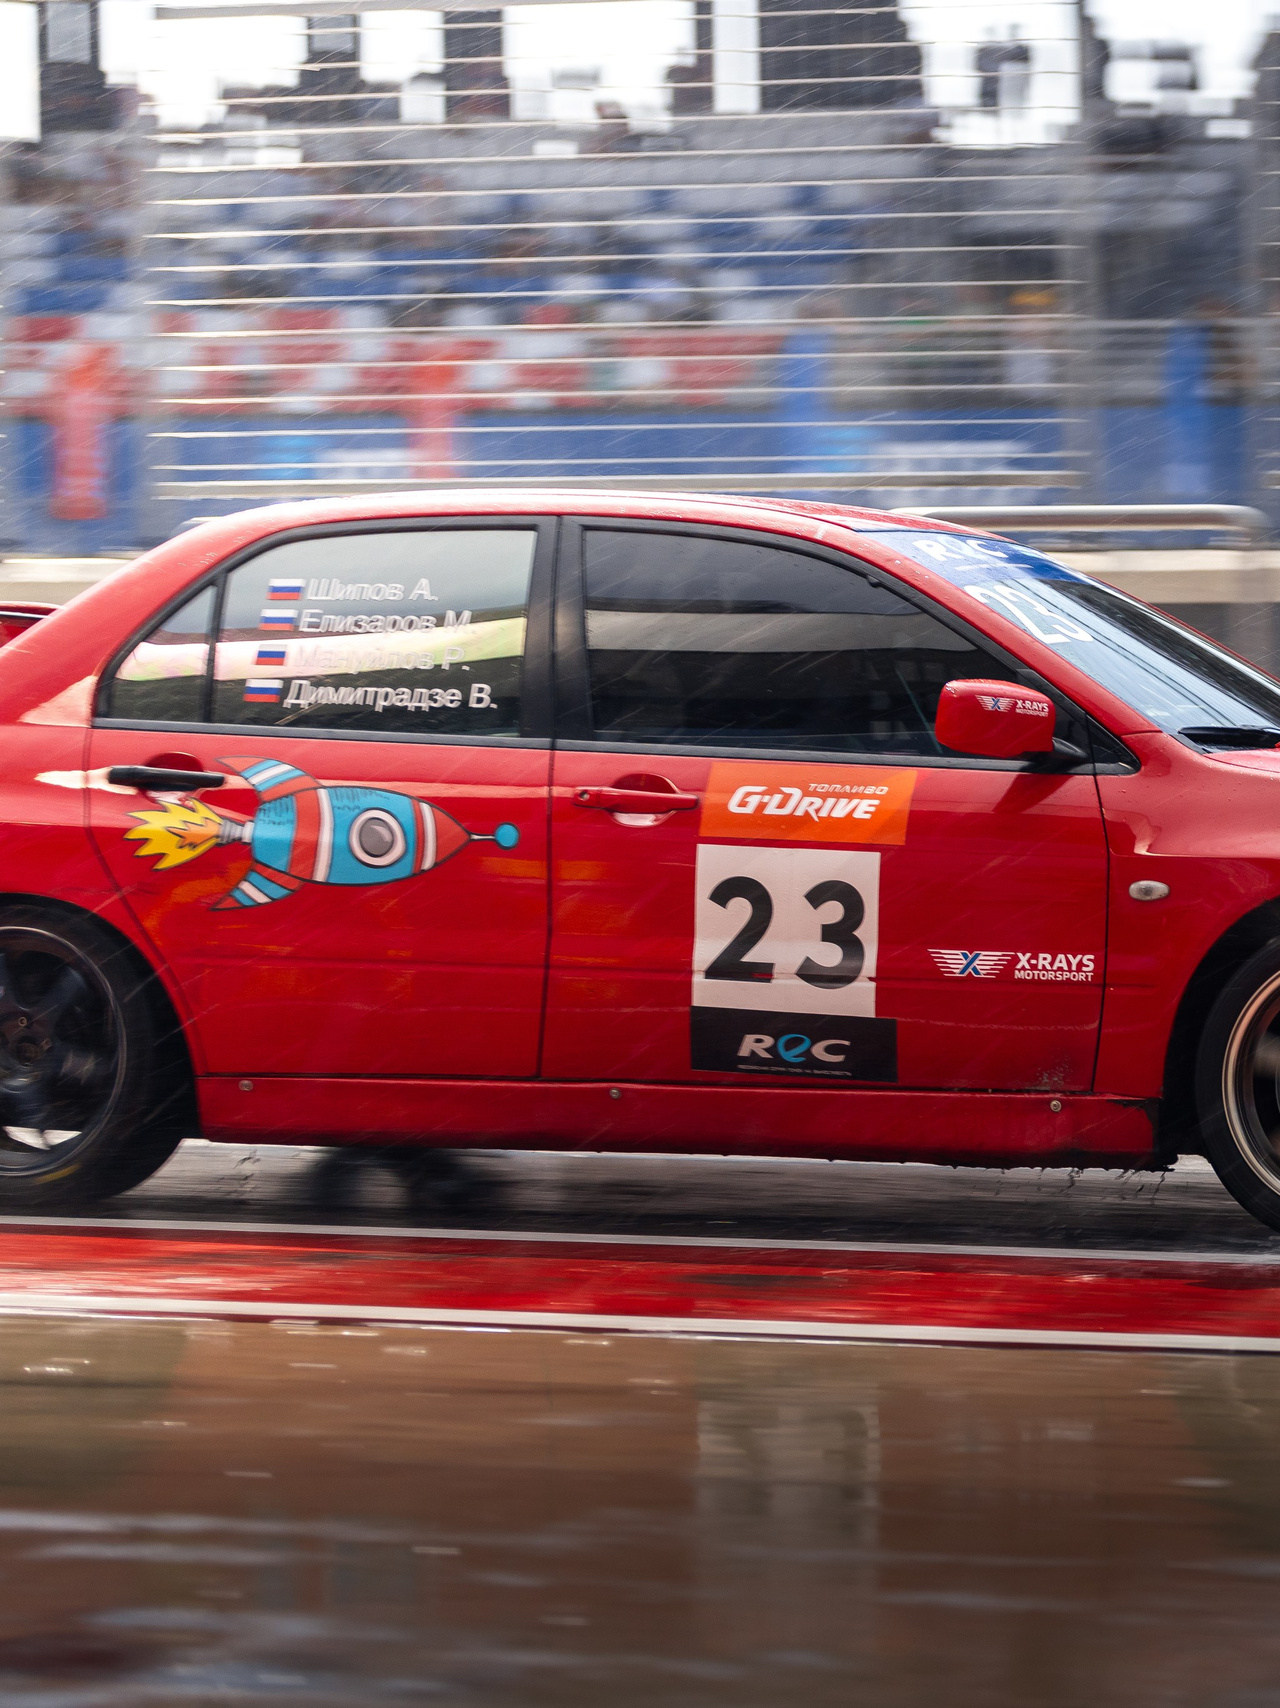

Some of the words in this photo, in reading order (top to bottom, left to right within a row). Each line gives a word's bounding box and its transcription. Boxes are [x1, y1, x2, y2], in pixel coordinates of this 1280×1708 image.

[964, 584, 1094, 644] 23
[283, 679, 462, 713] Димитрадзе
[468, 683, 498, 709] В.
[1016, 699, 1049, 712] X-RAYS
[808, 783, 889, 795] ТОПЛИВО
[705, 876, 865, 989] 23
[1016, 952, 1095, 971] X-RAYS
[1014, 970, 1094, 981] MOTORSPORT
